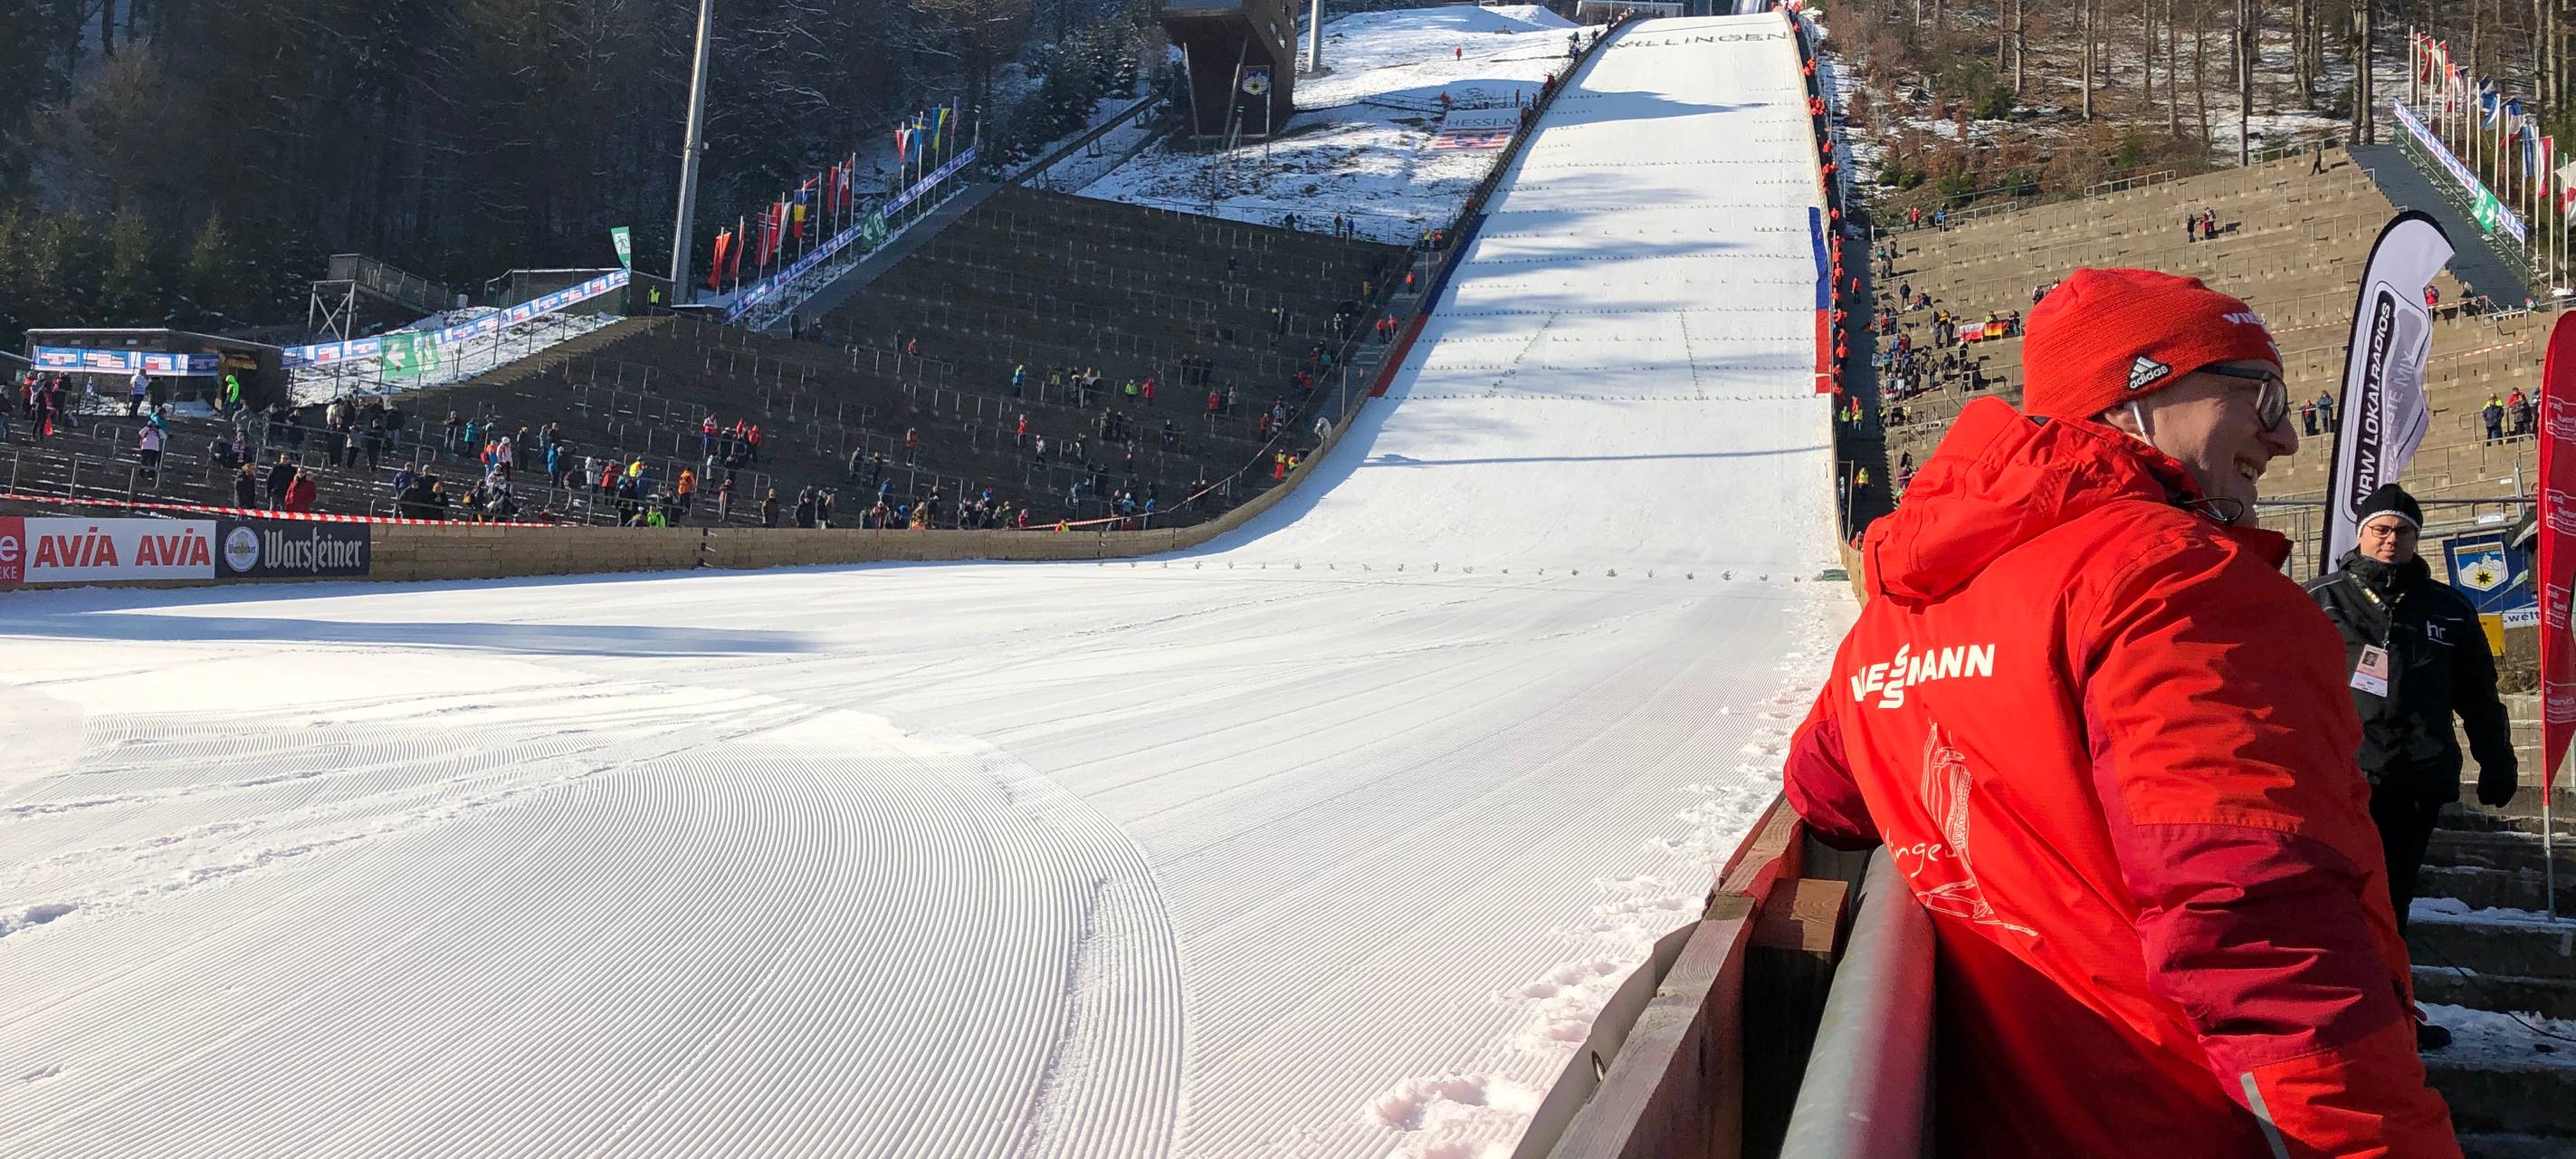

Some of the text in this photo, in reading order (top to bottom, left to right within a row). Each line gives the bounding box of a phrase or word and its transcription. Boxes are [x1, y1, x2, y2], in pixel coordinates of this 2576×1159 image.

[1447, 117, 1517, 127] HESSEN
[2129, 365, 2169, 389] adidas
[2393, 350, 2414, 387] MIX
[2356, 302, 2390, 505] NRW LOKALRADIOS
[33, 526, 119, 568] AVIA
[134, 527, 212, 567] AVIA
[263, 526, 363, 573] Warsteiner
[2427, 620, 2447, 639] hr
